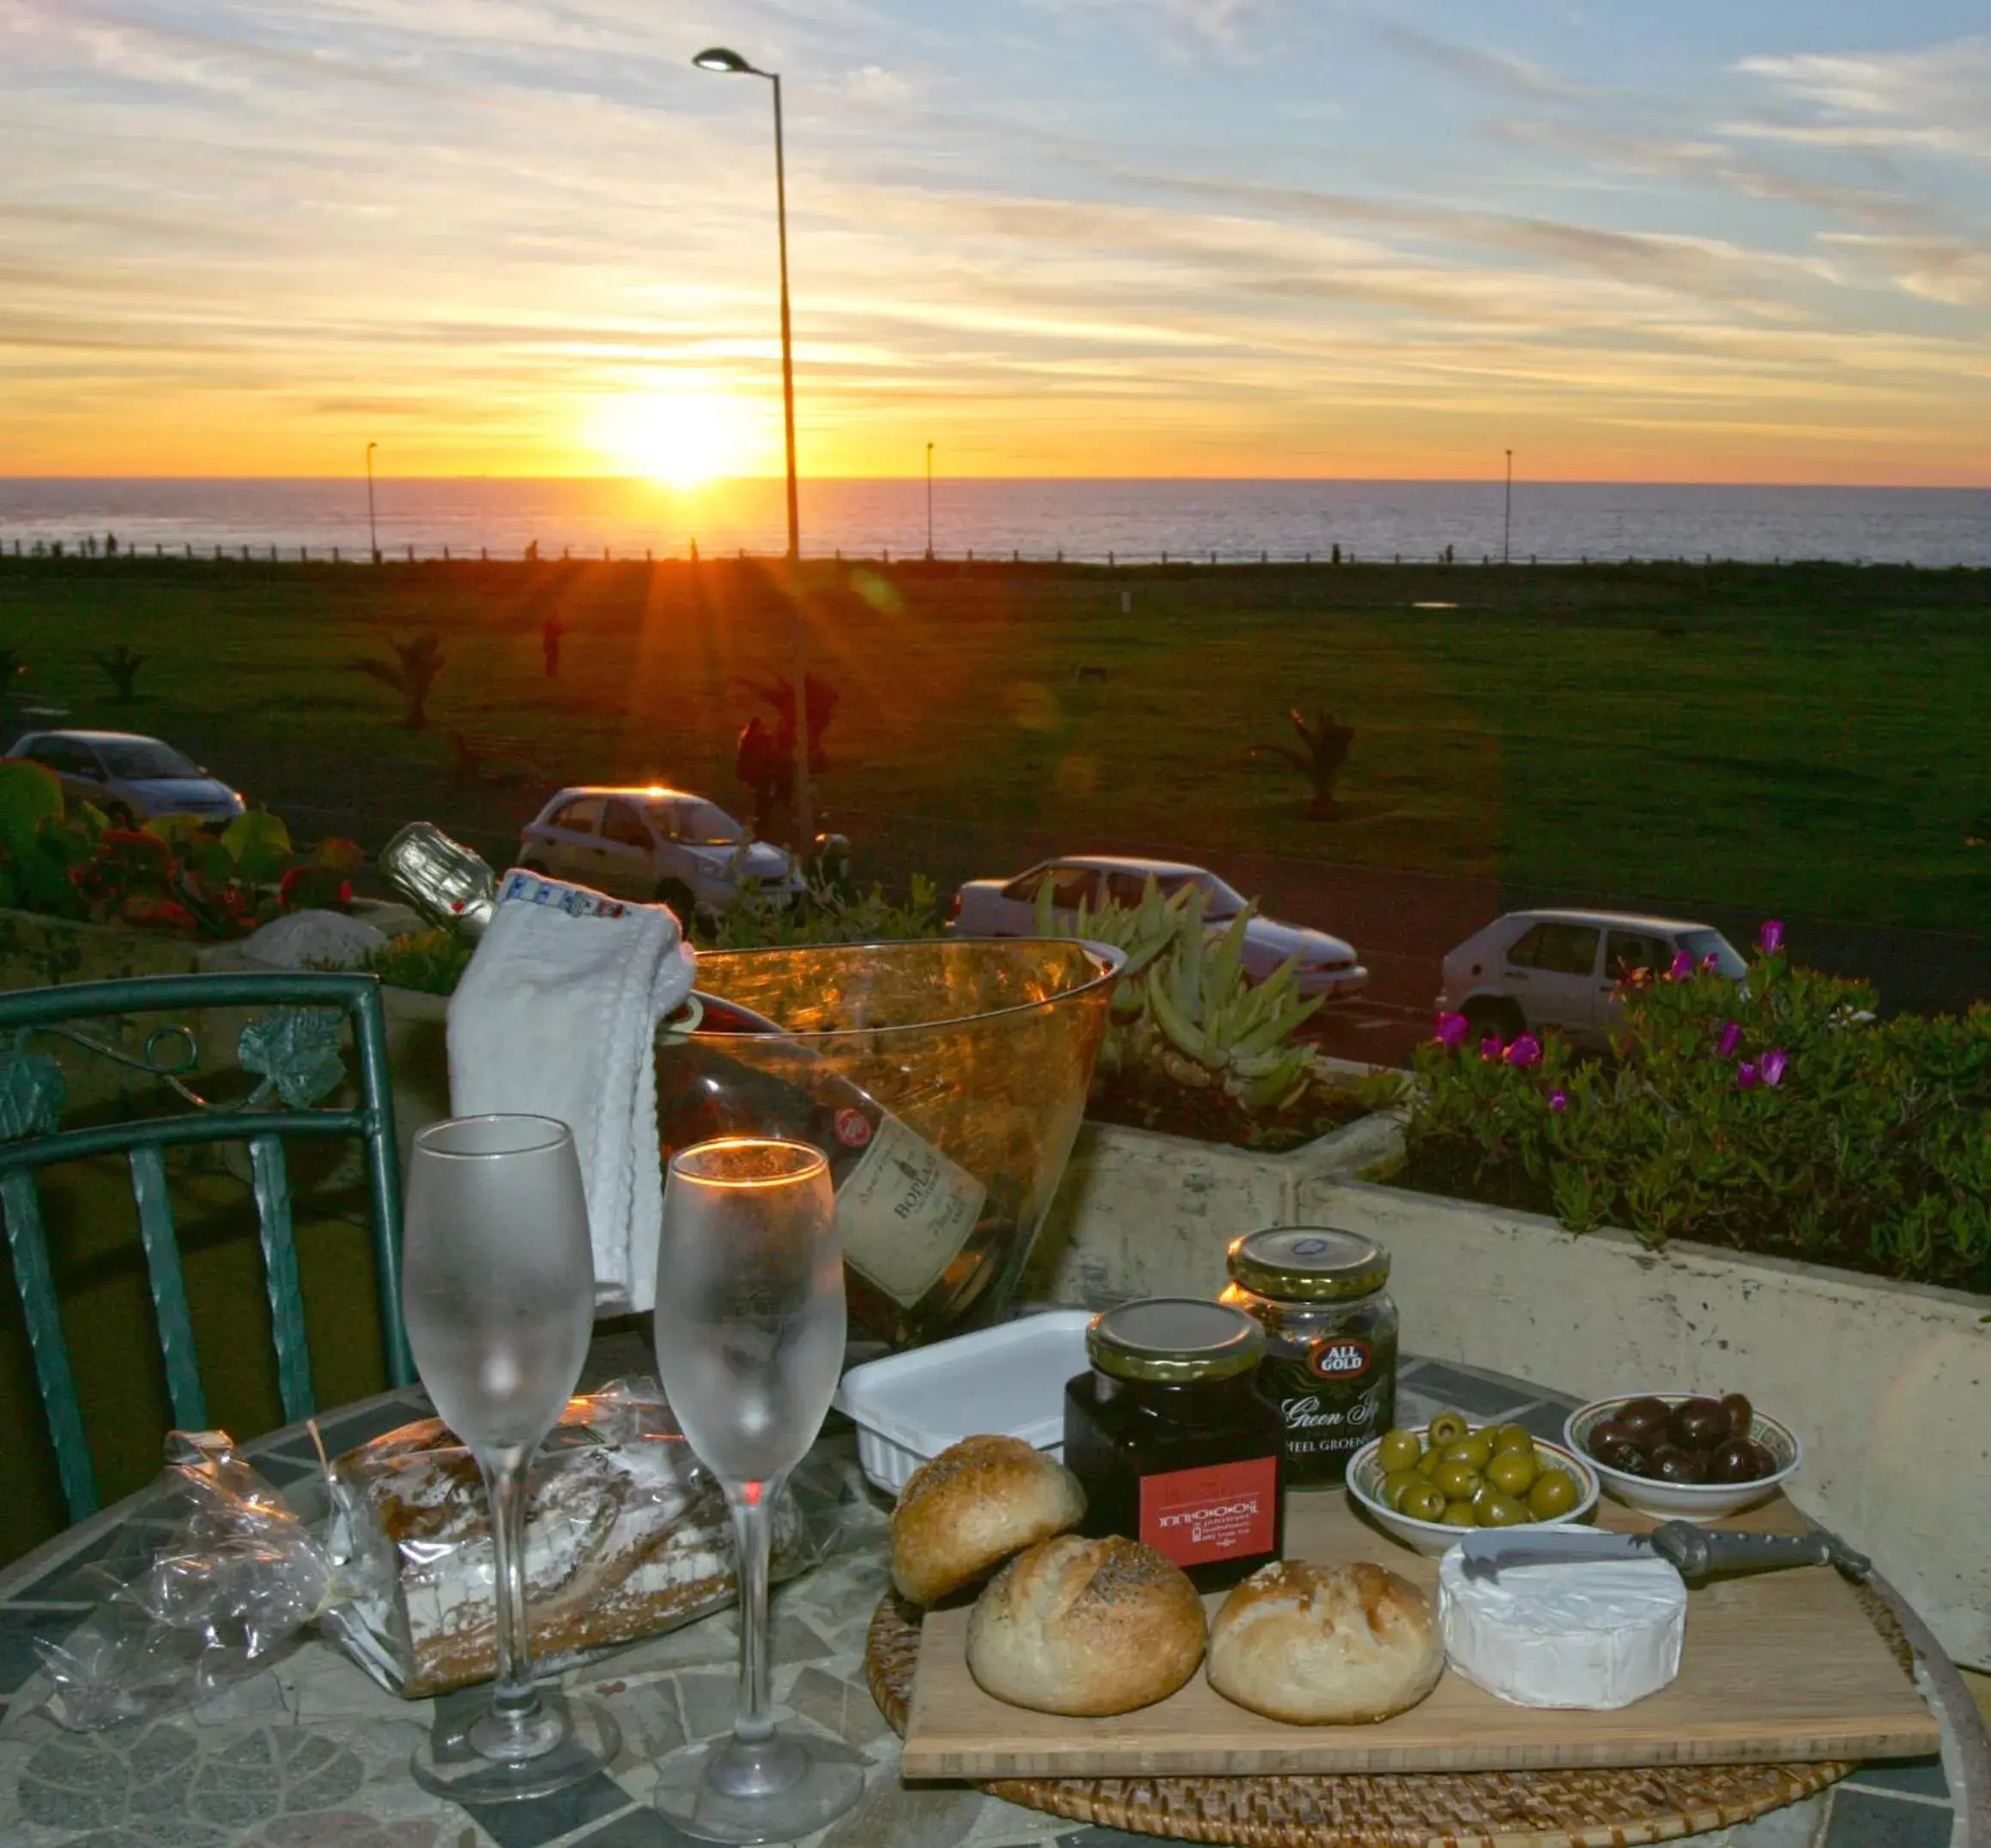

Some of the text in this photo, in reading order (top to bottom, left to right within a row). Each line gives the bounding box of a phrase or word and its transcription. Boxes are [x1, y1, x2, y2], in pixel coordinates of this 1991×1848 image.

[1328, 1345, 1358, 1357] ALL
[1321, 1357, 1363, 1371] GOLD
[1281, 1395, 1345, 1429] Green
